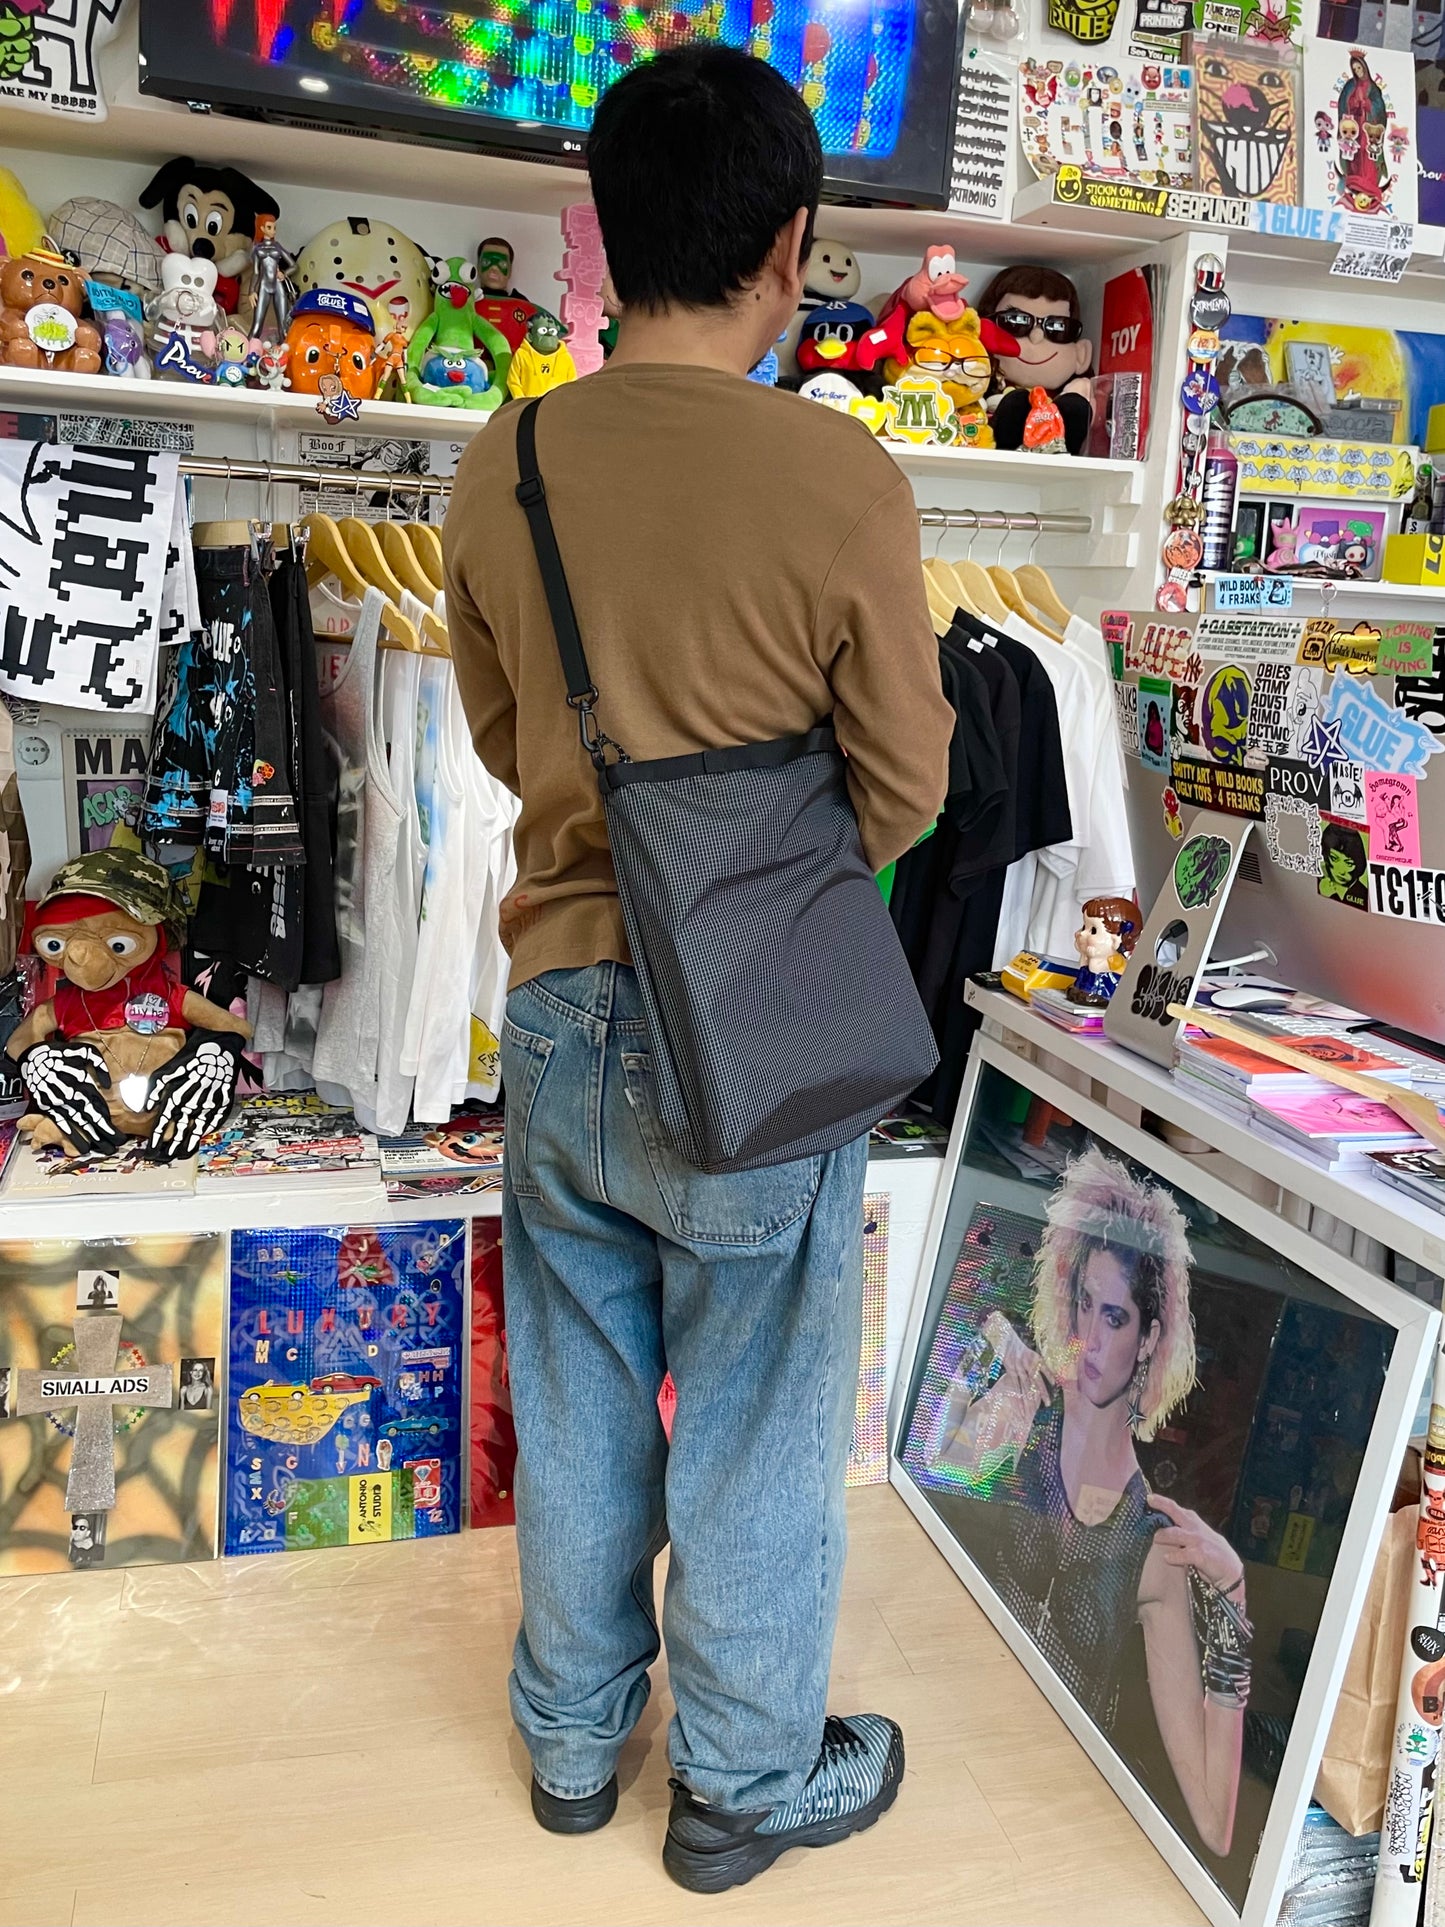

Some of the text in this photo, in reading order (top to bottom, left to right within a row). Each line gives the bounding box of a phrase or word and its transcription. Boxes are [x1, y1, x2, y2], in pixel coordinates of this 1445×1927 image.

[1140, 12, 1184, 28] PRINTING
[1205, 21, 1238, 34] ONE
[28, 89, 48, 101] MY
[1085, 183, 1132, 198] STICKIN ON
[1168, 194, 1249, 226] SEAPUNCH
[1273, 205, 1323, 235] GLUE
[320, 296, 342, 307] GLUE
[1111, 324, 1141, 358] TOY
[161, 341, 213, 384] Prove
[897, 394, 937, 427] M
[1218, 580, 1265, 592] WILD BOOKS
[1219, 594, 1225, 605] 4
[1385, 623, 1432, 640] LOVING
[1397, 641, 1412, 654] IS
[1257, 663, 1291, 680] OBIES
[1382, 656, 1427, 674] LIVING
[1254, 678, 1290, 695] STIMY
[1250, 708, 1280, 725] RIMO
[1248, 722, 1290, 742] OCTWO
[1341, 700, 1402, 770] GLUE
[1173, 761, 1264, 795] SHITTY ART WILD BOOKS
[1332, 761, 1363, 782] WASTE!
[1175, 780, 1193, 798] UGLY
[1193, 784, 1212, 803] TOYS
[1217, 789, 1224, 806] 4
[1346, 894, 1365, 906] GLUE
[42, 1377, 149, 1397] SMALL ADS
[359, 1479, 367, 1518] ANTONIO
